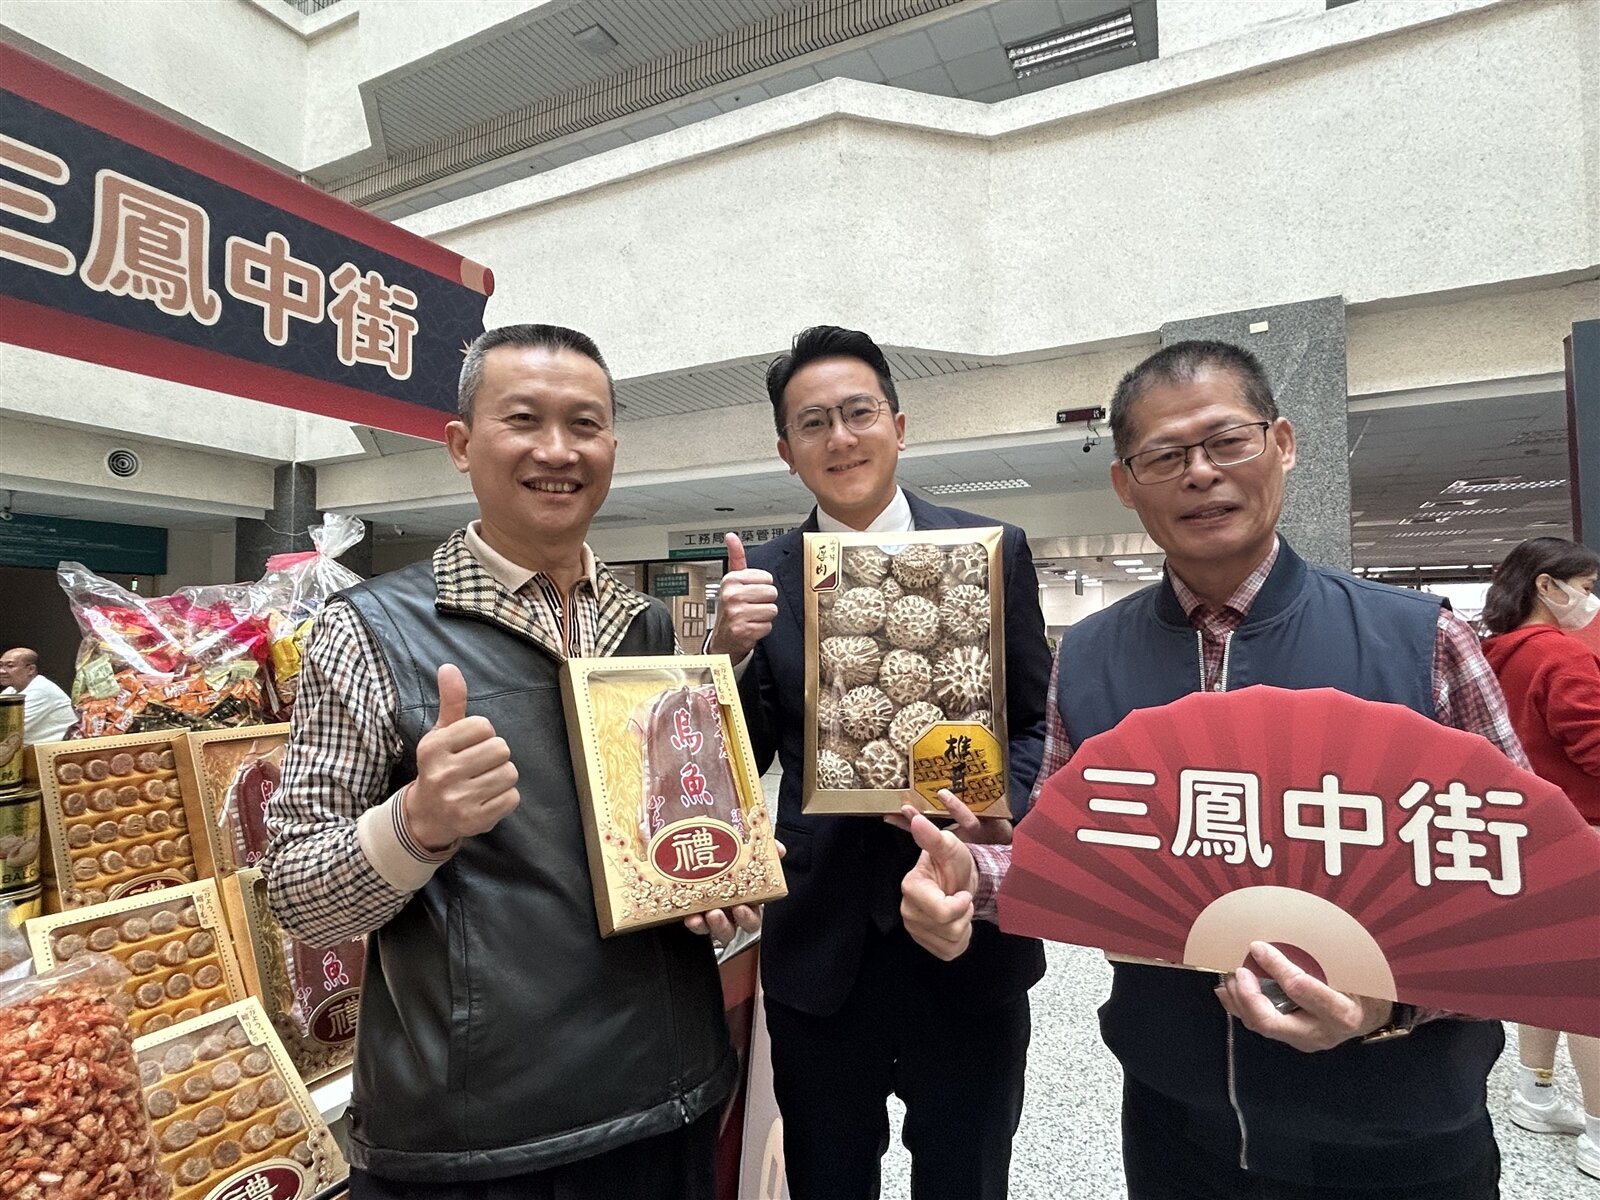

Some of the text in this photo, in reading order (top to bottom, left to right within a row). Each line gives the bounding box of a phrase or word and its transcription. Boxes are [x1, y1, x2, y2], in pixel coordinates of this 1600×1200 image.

[0, 135, 418, 381] 三鳳中街
[684, 526, 798, 546] 工務局築管理
[671, 827, 728, 872] 禮
[1077, 768, 1528, 896] 三鳳中街
[322, 951, 350, 991] 魚
